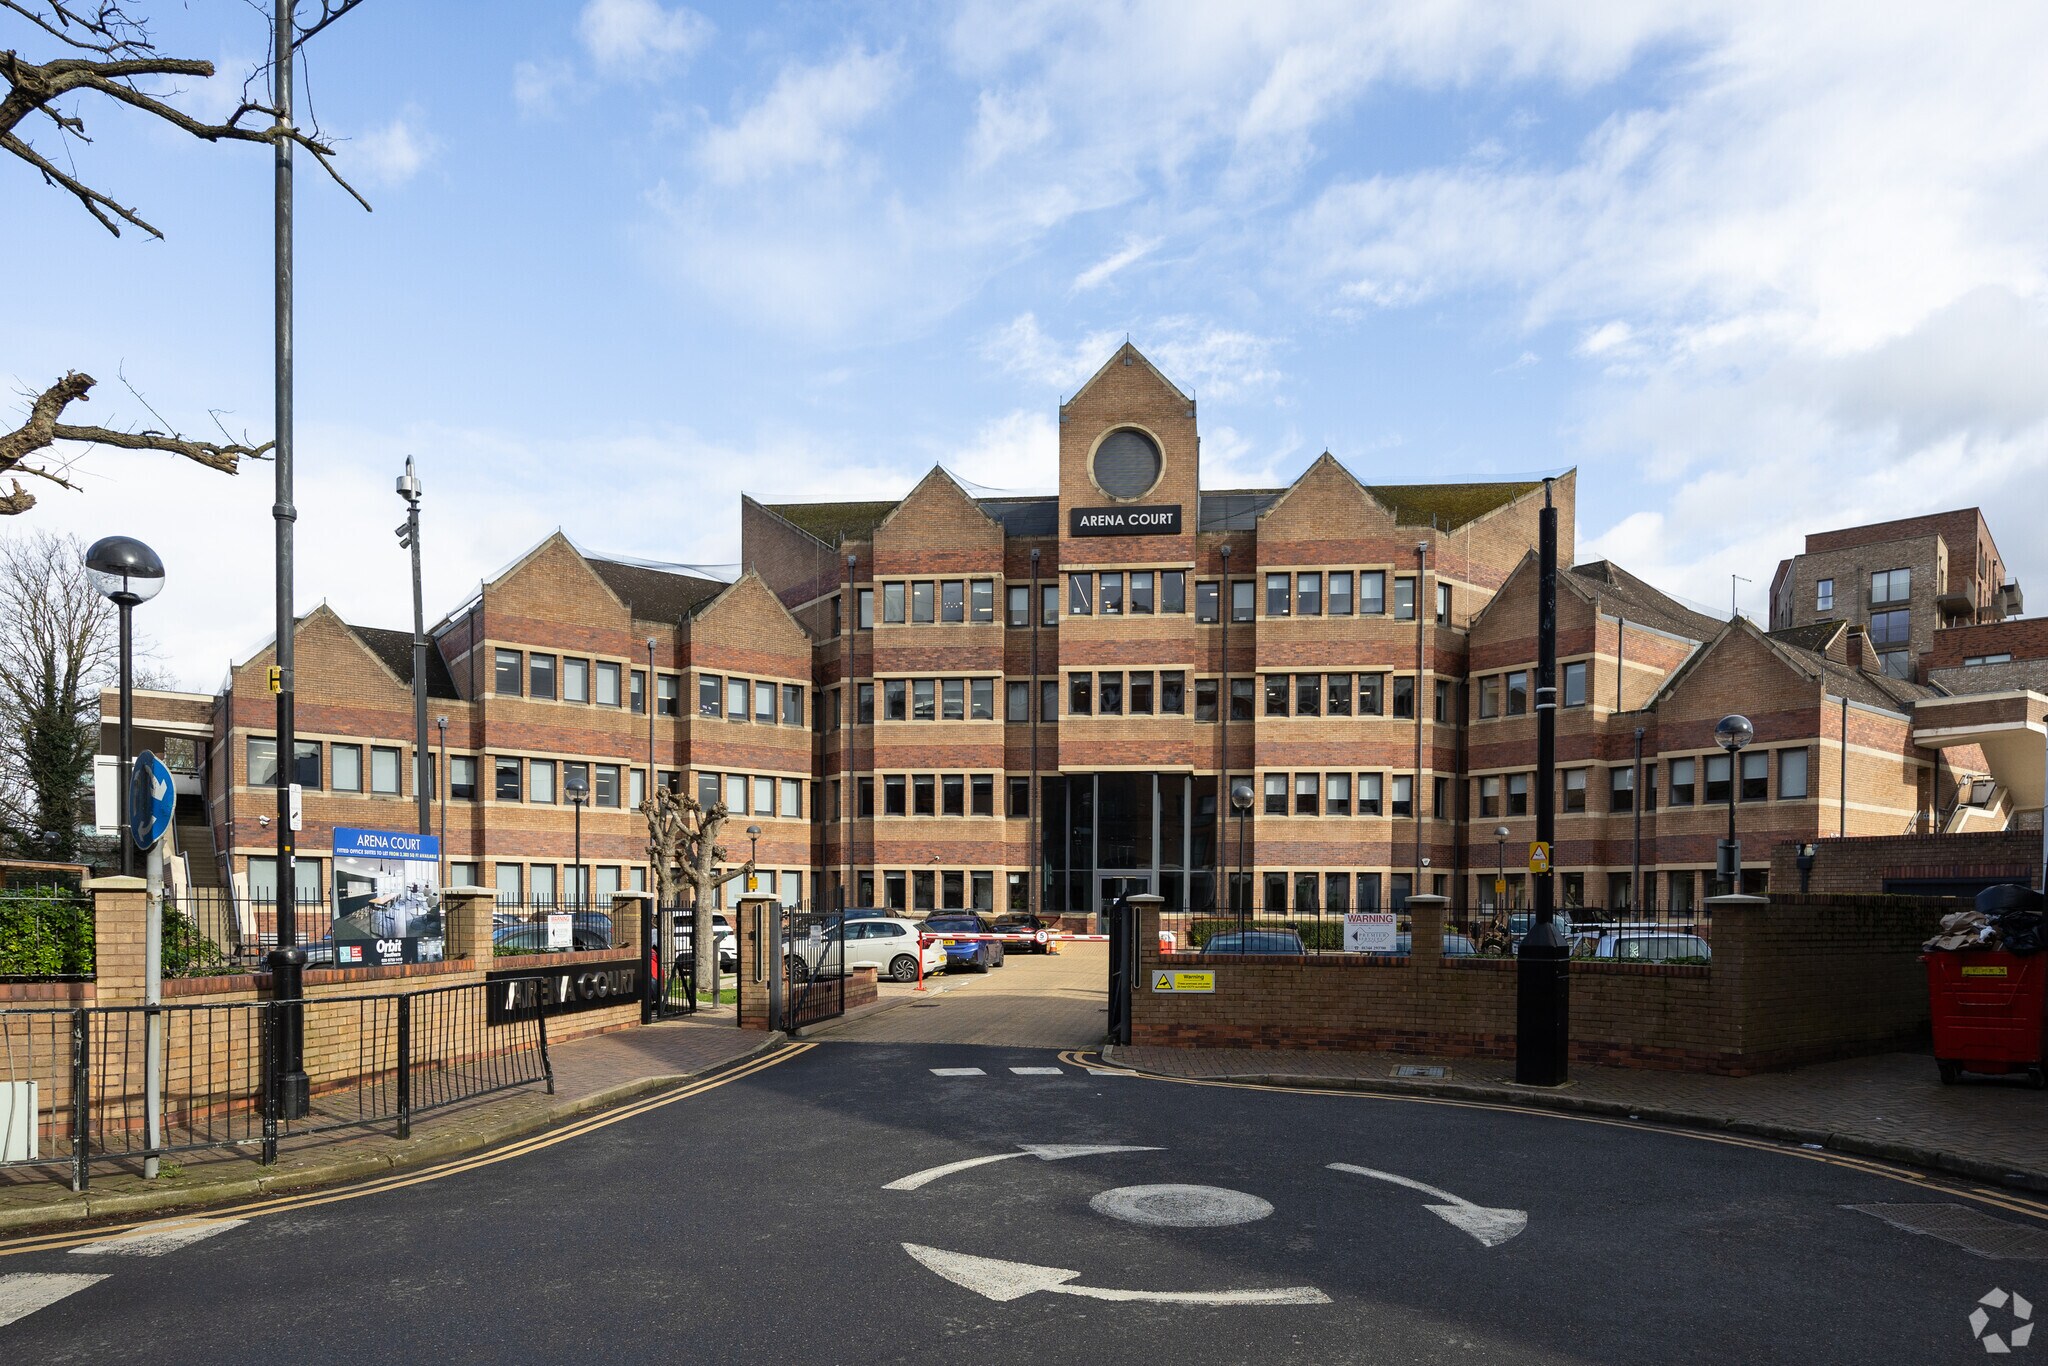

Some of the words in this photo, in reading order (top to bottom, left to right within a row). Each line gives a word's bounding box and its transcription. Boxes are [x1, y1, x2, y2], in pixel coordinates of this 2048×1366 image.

[1080, 515, 1124, 527] ARENA
[1128, 513, 1173, 525] COURT
[357, 834, 388, 848] ARENA
[390, 837, 420, 850] COURT
[1347, 914, 1393, 923] WARNING
[376, 939, 402, 953] Orbit
[505, 975, 576, 1010] ARENA
[578, 969, 636, 1000] COURT
